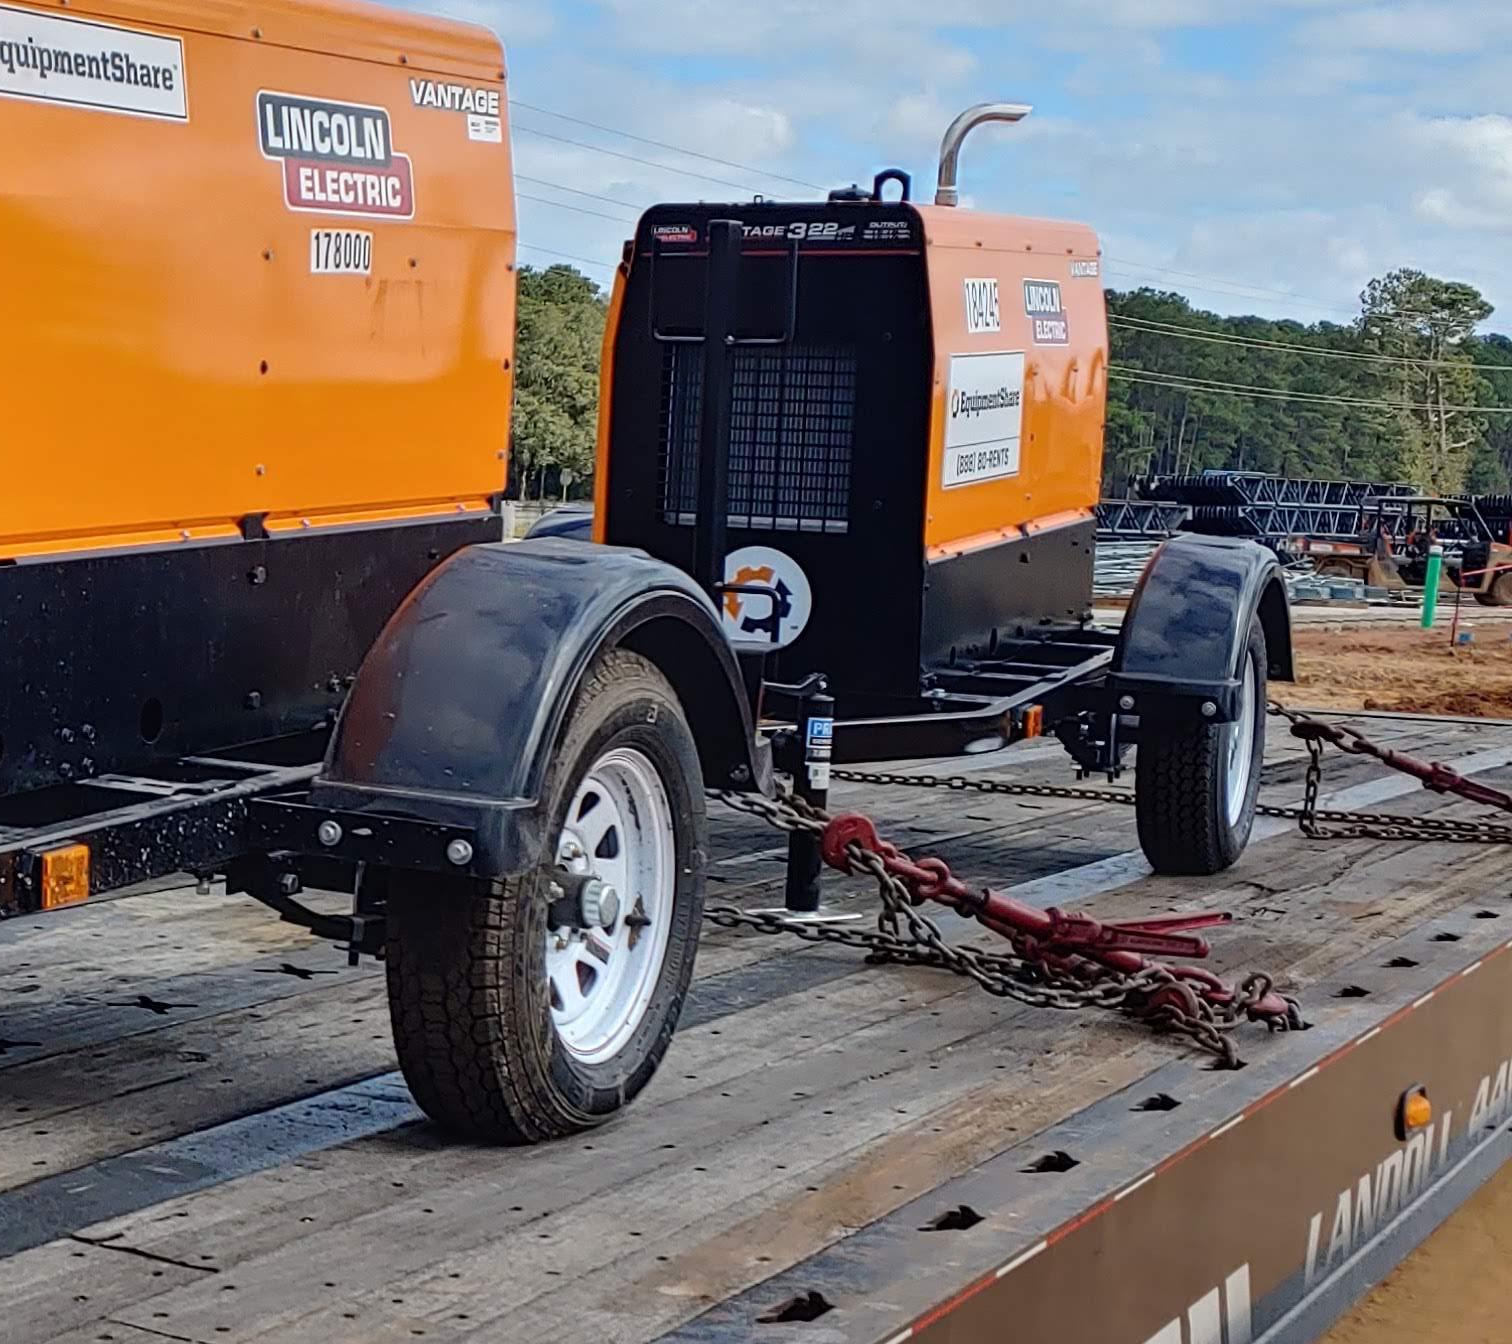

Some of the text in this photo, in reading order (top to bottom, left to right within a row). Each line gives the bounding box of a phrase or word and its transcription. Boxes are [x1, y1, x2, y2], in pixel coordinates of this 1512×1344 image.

[409, 79, 500, 115] VANTAGE
[265, 103, 386, 160] LINCOLN
[299, 167, 402, 207] ELECTRIC
[741, 222, 839, 240] TAGE 322
[314, 231, 371, 270] 178000
[1024, 285, 1061, 313] LINCOLN
[1036, 320, 1067, 340] ELECTRIC
[960, 387, 1020, 418] EquipmentShare
[1469, 1058, 1512, 1140] 44
